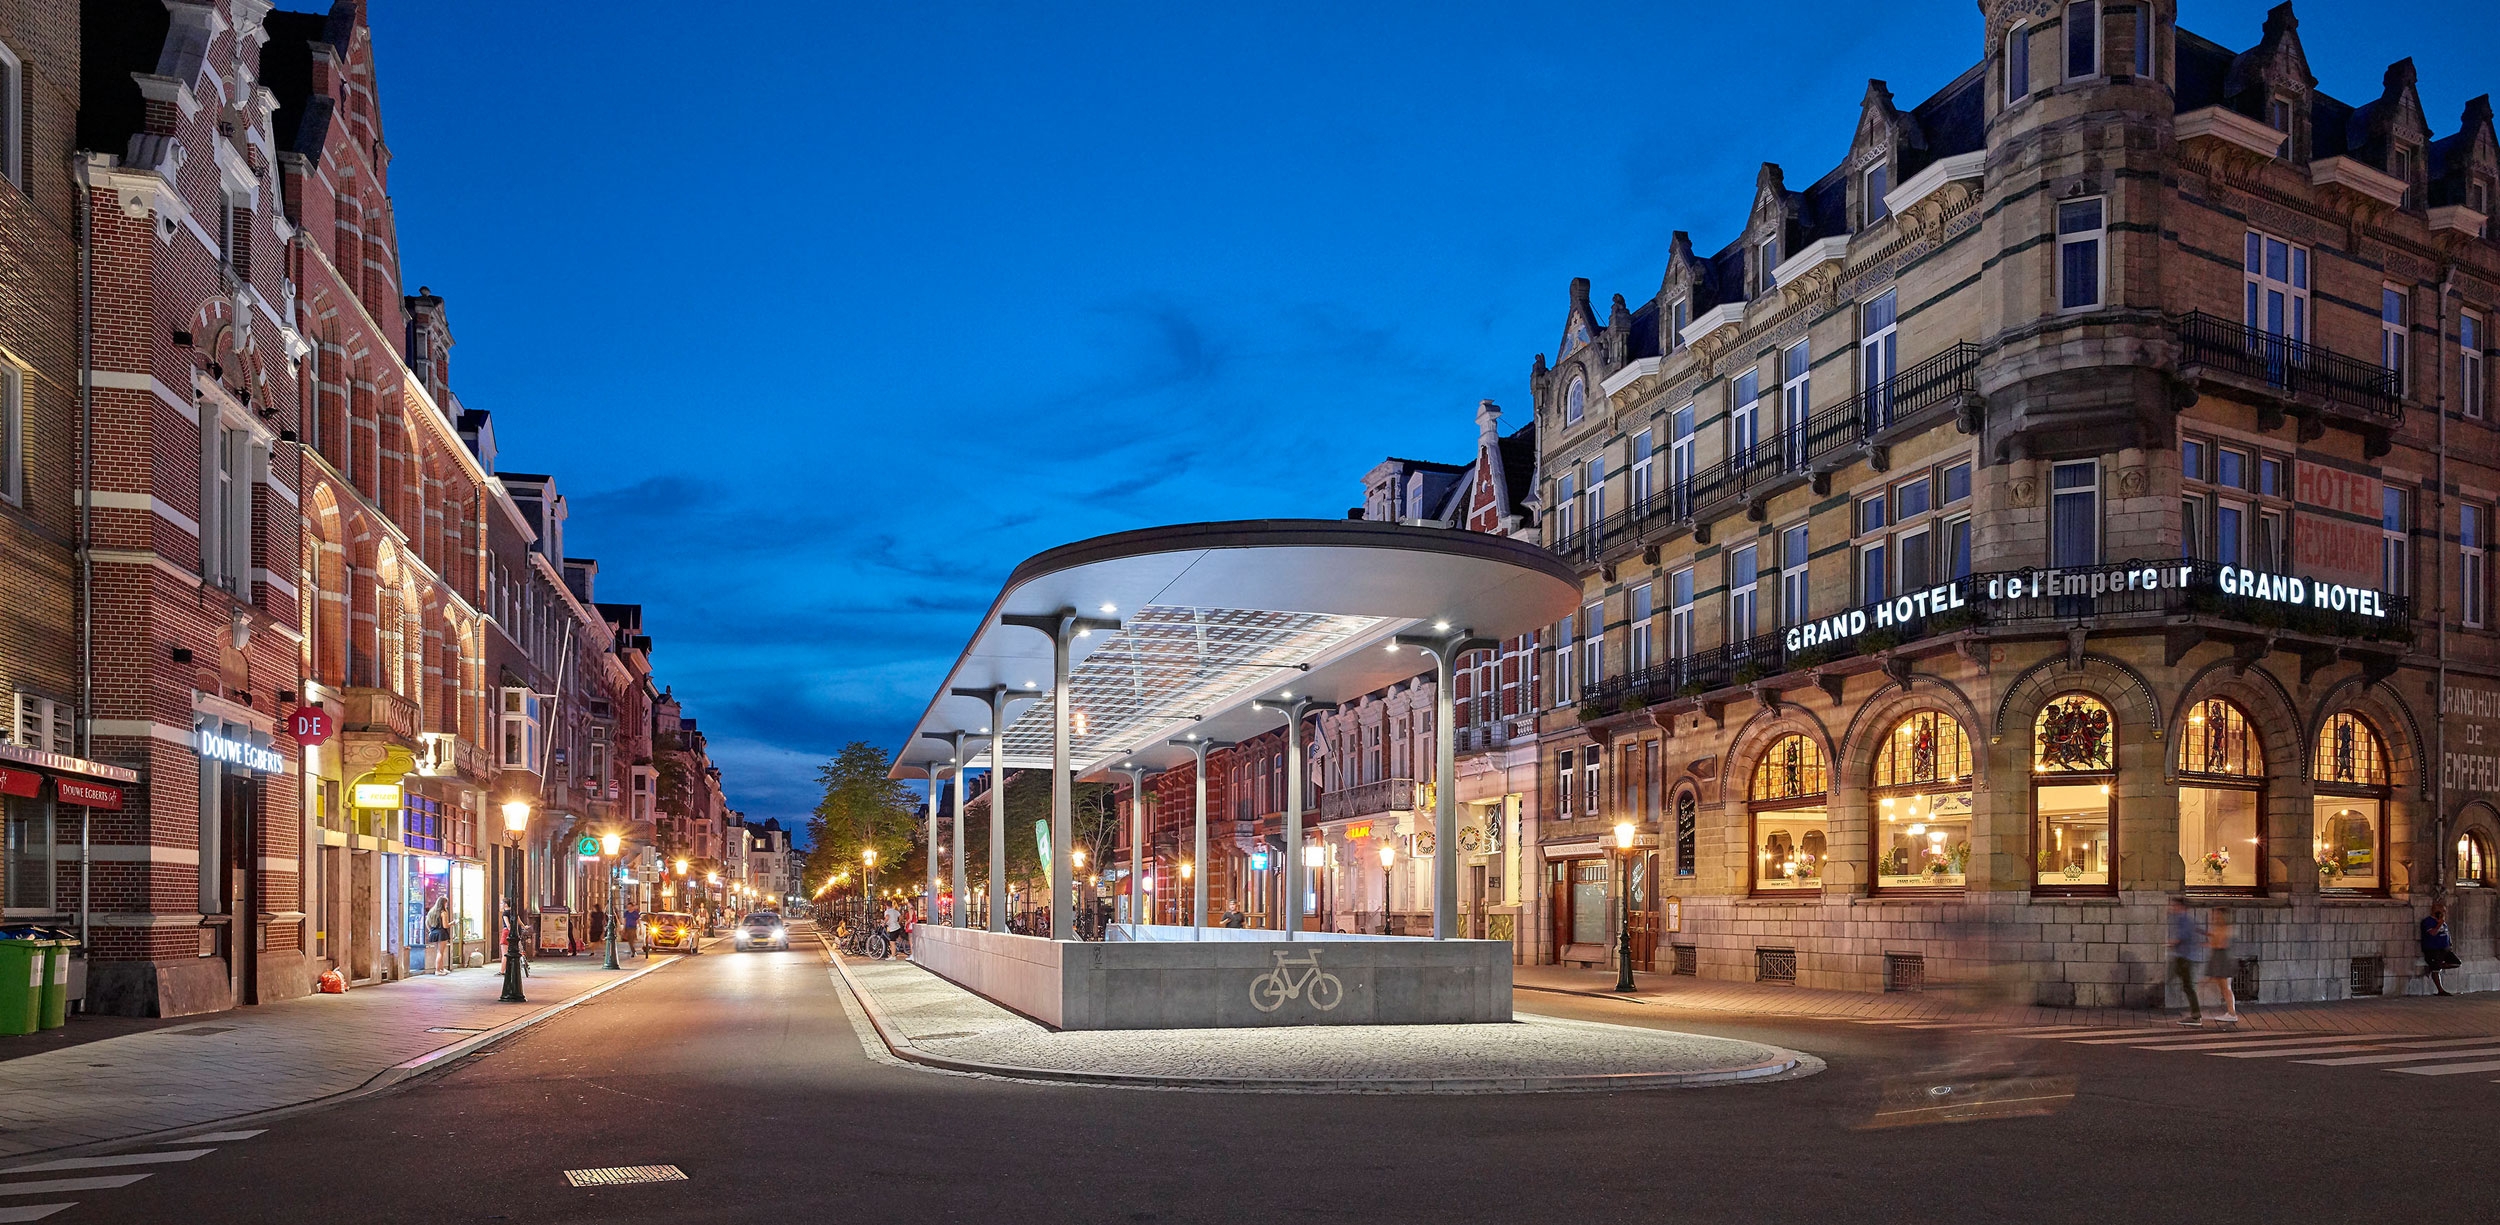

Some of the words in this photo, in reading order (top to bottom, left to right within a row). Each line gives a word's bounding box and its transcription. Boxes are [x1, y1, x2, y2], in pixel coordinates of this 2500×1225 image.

[2298, 462, 2380, 518] HOTEL
[1786, 610, 1866, 652] GRAND
[1877, 582, 1965, 629] HOTEL
[1988, 573, 2022, 600] de
[2032, 565, 2193, 599] l'Empereur
[2219, 565, 2305, 605] GRAND
[2314, 581, 2385, 618] HOTEL
[2477, 690, 2500, 719] HOT
[202, 730, 242, 764] DOUWE
[244, 743, 283, 774] EGBERTS
[2466, 724, 2483, 746] DE
[62, 783, 84, 798] DOUWE
[85, 787, 108, 801] EGBERTS
[2443, 752, 2500, 792] EMPEREU
